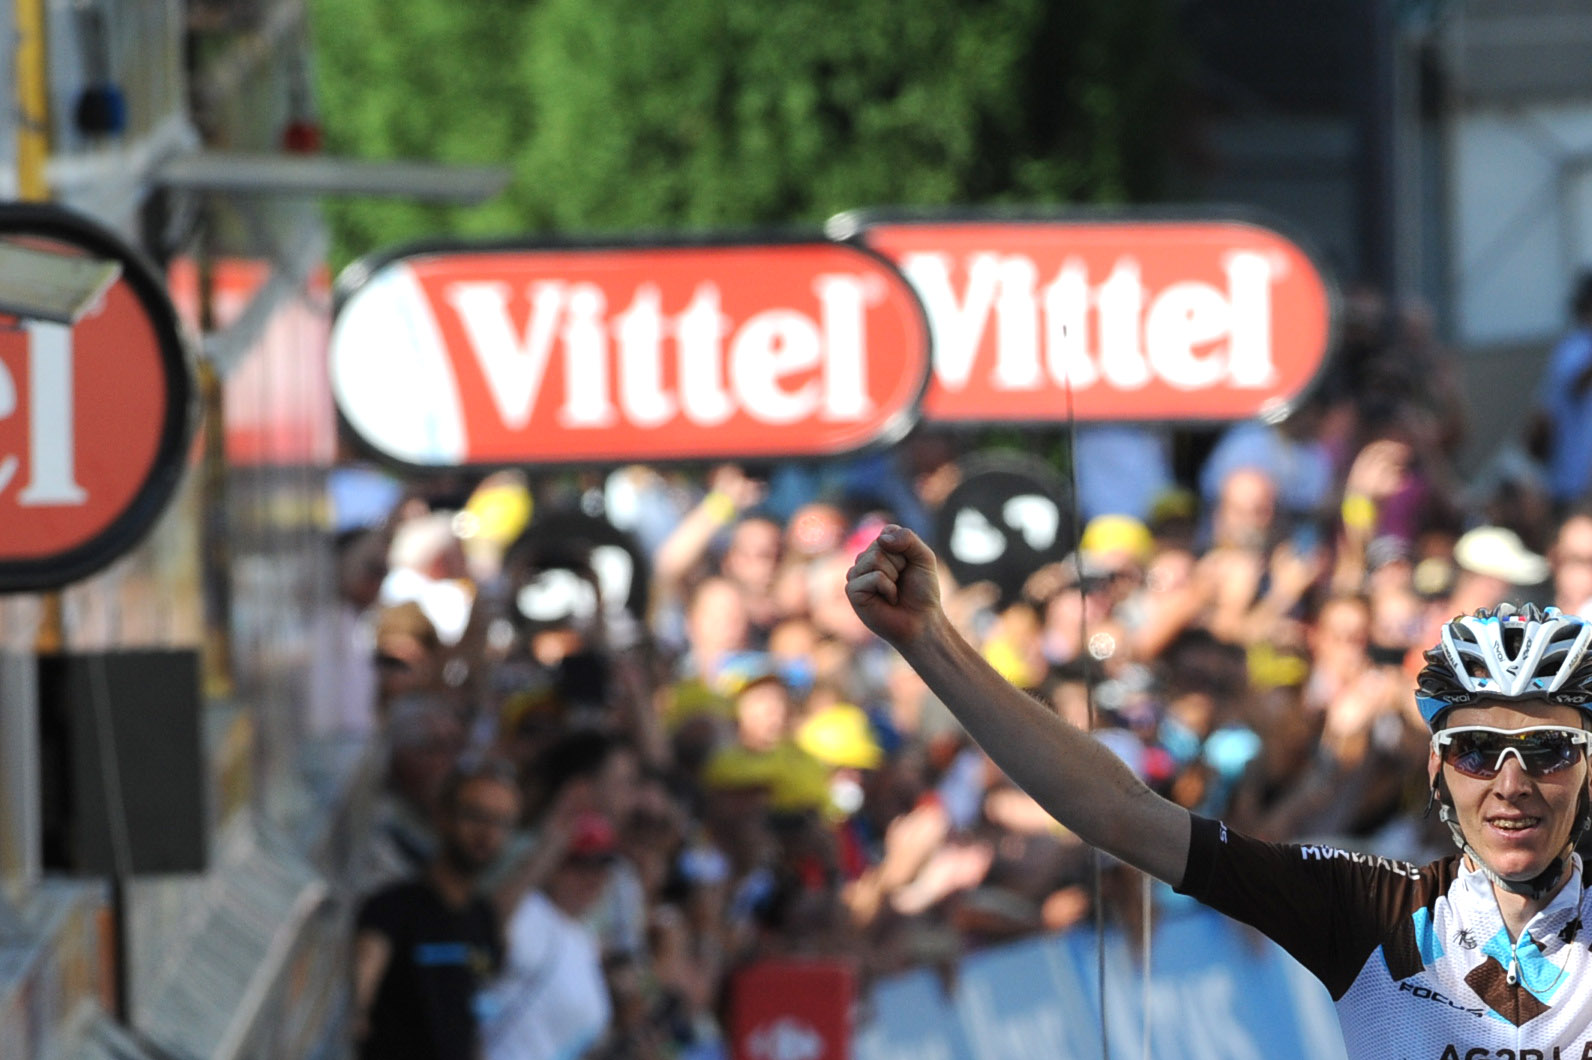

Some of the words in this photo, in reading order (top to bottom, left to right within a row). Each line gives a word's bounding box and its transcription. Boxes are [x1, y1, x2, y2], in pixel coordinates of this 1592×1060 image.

[448, 273, 869, 430] Vittel
[903, 253, 1277, 388] Vittel
[1399, 981, 1484, 1018] FOCUS
